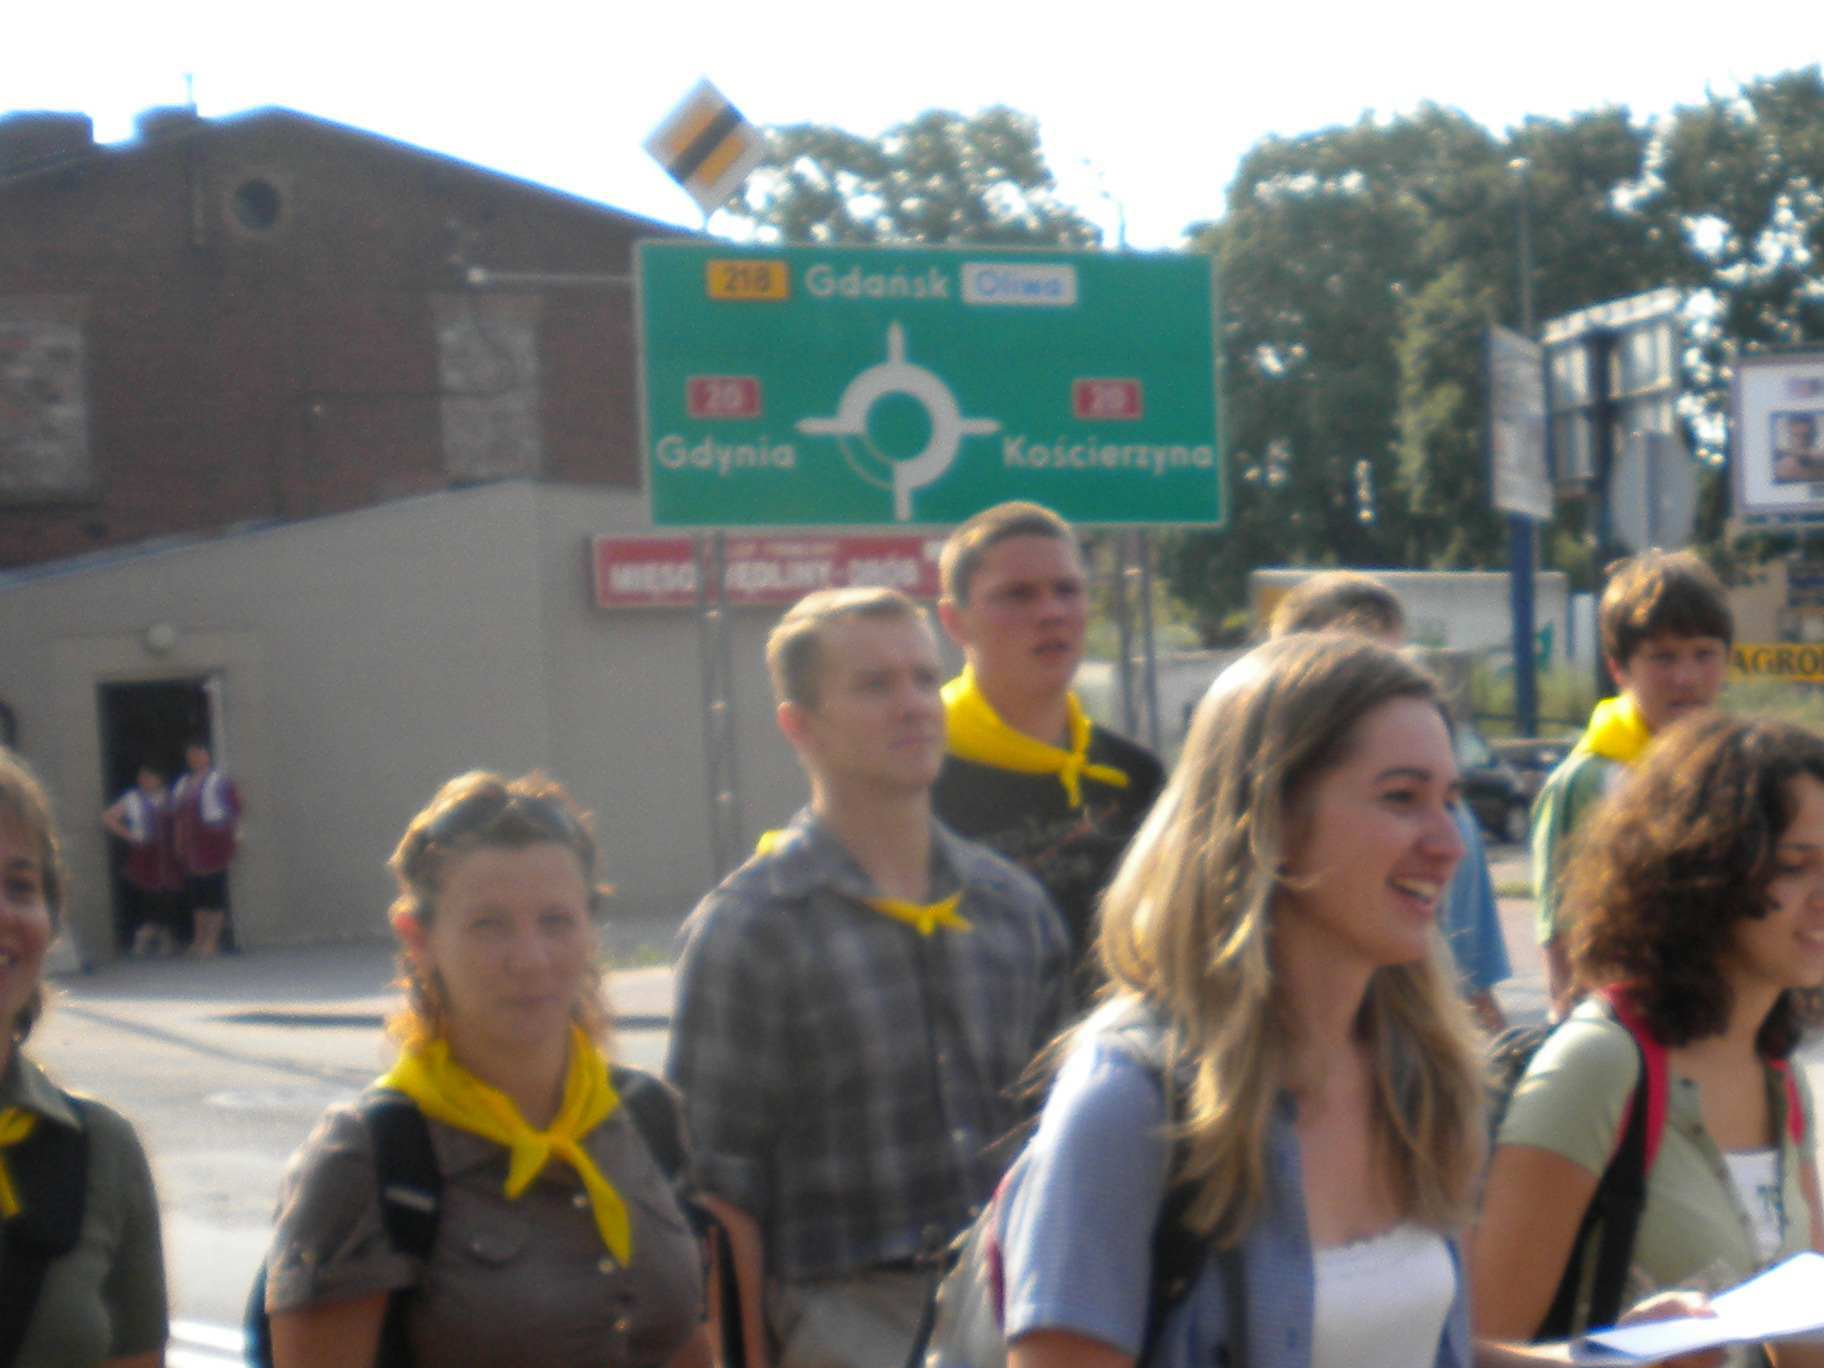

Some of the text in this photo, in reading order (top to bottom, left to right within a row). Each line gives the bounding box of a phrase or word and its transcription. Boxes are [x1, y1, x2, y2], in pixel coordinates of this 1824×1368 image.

[722, 266, 770, 293] 218
[805, 264, 950, 299] Gdańsk
[656, 435, 797, 477] Gdynia
[1003, 435, 1214, 477] Kościerzyna
